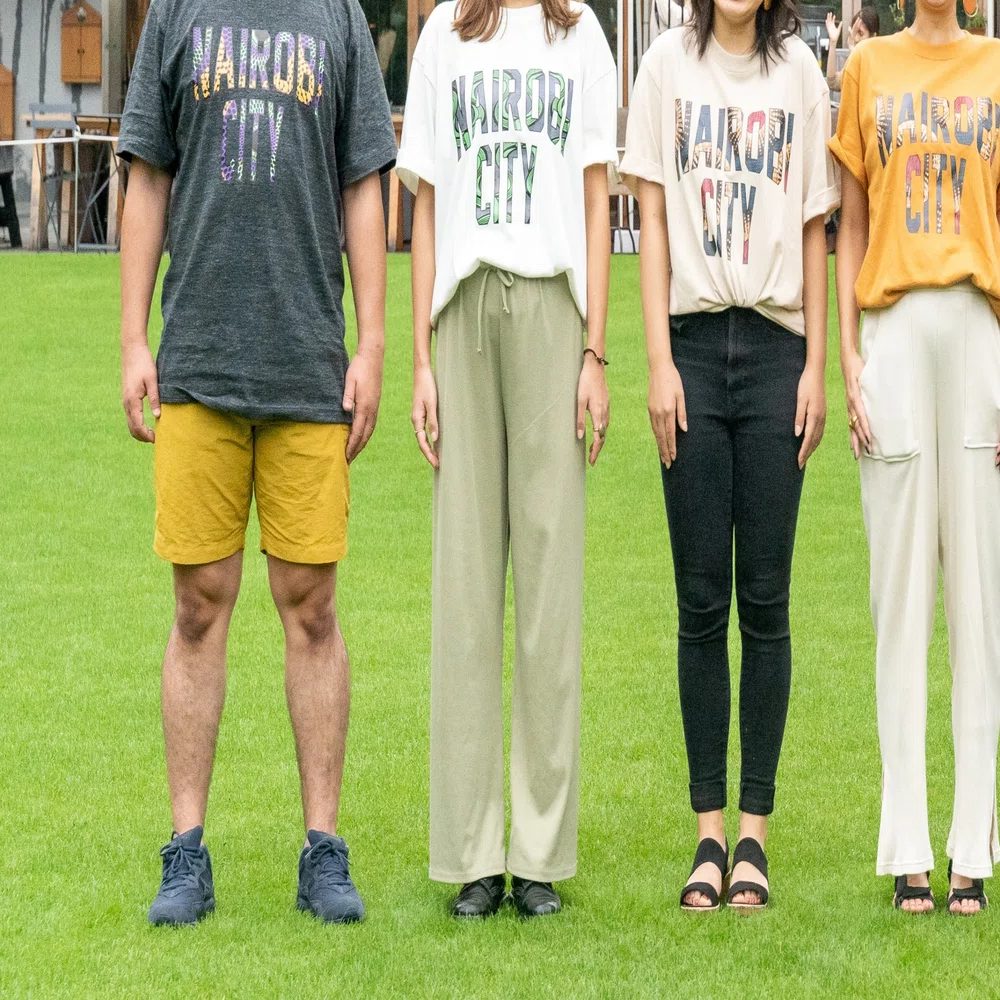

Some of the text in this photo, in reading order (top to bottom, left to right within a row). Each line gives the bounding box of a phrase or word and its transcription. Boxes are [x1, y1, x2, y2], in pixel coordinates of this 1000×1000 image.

[192, 26, 326, 115] NAIROBI
[220, 98, 285, 183] CITY
[451, 68, 575, 162] NAIROBI
[675, 98, 796, 195] NAIROBI
[876, 91, 1000, 169] NAIROBI
[475, 141, 538, 226] CITY
[701, 177, 757, 265] CITY
[906, 152, 967, 235] CITY
